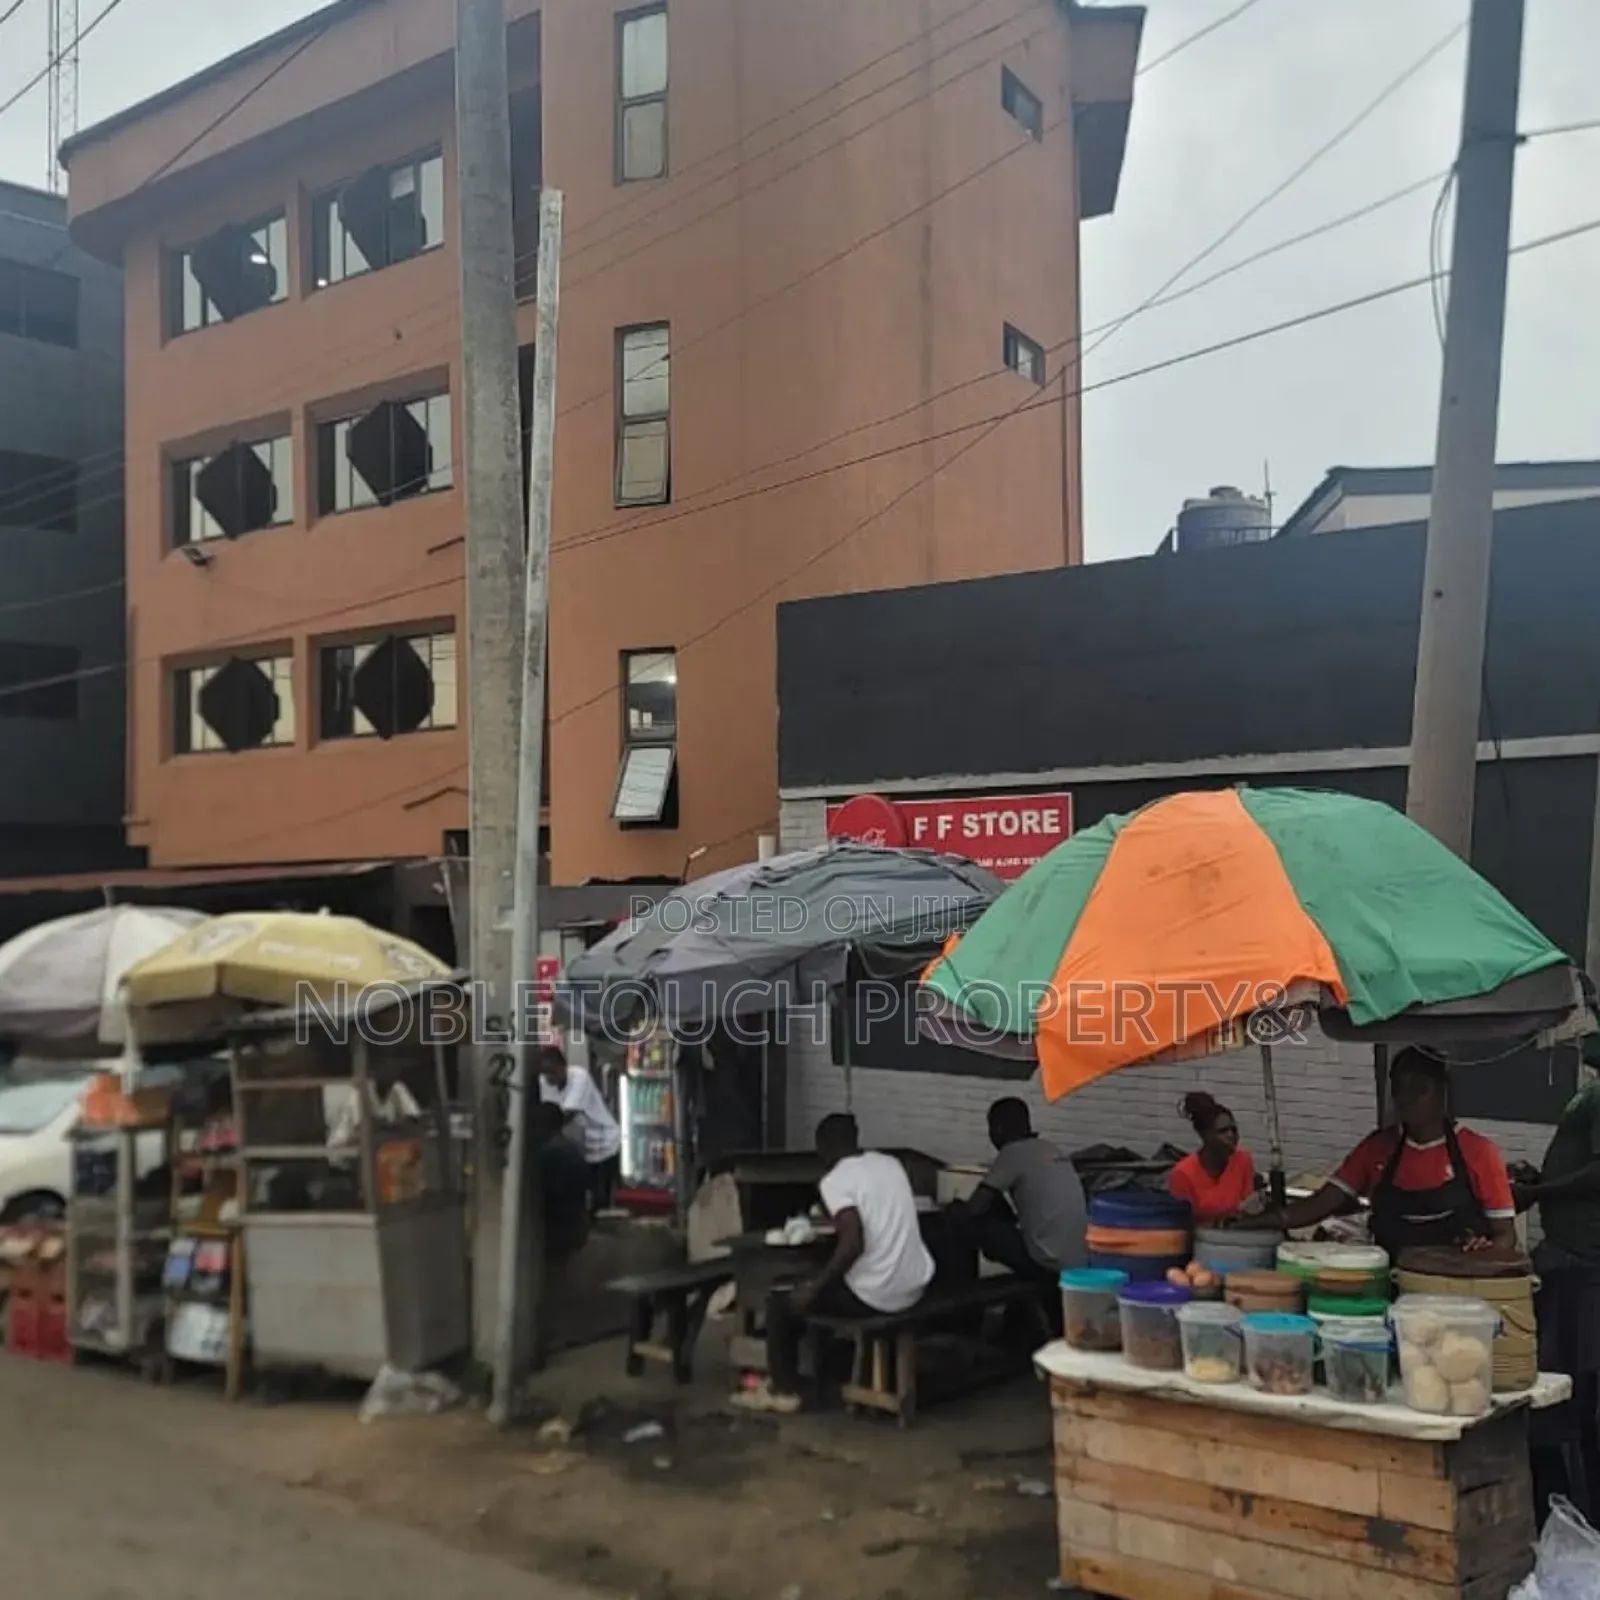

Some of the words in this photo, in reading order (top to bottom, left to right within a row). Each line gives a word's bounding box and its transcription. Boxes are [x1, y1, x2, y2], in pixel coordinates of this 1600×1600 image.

[913, 816, 928, 841] F
[937, 814, 953, 840] F
[962, 808, 1061, 838] STORE
